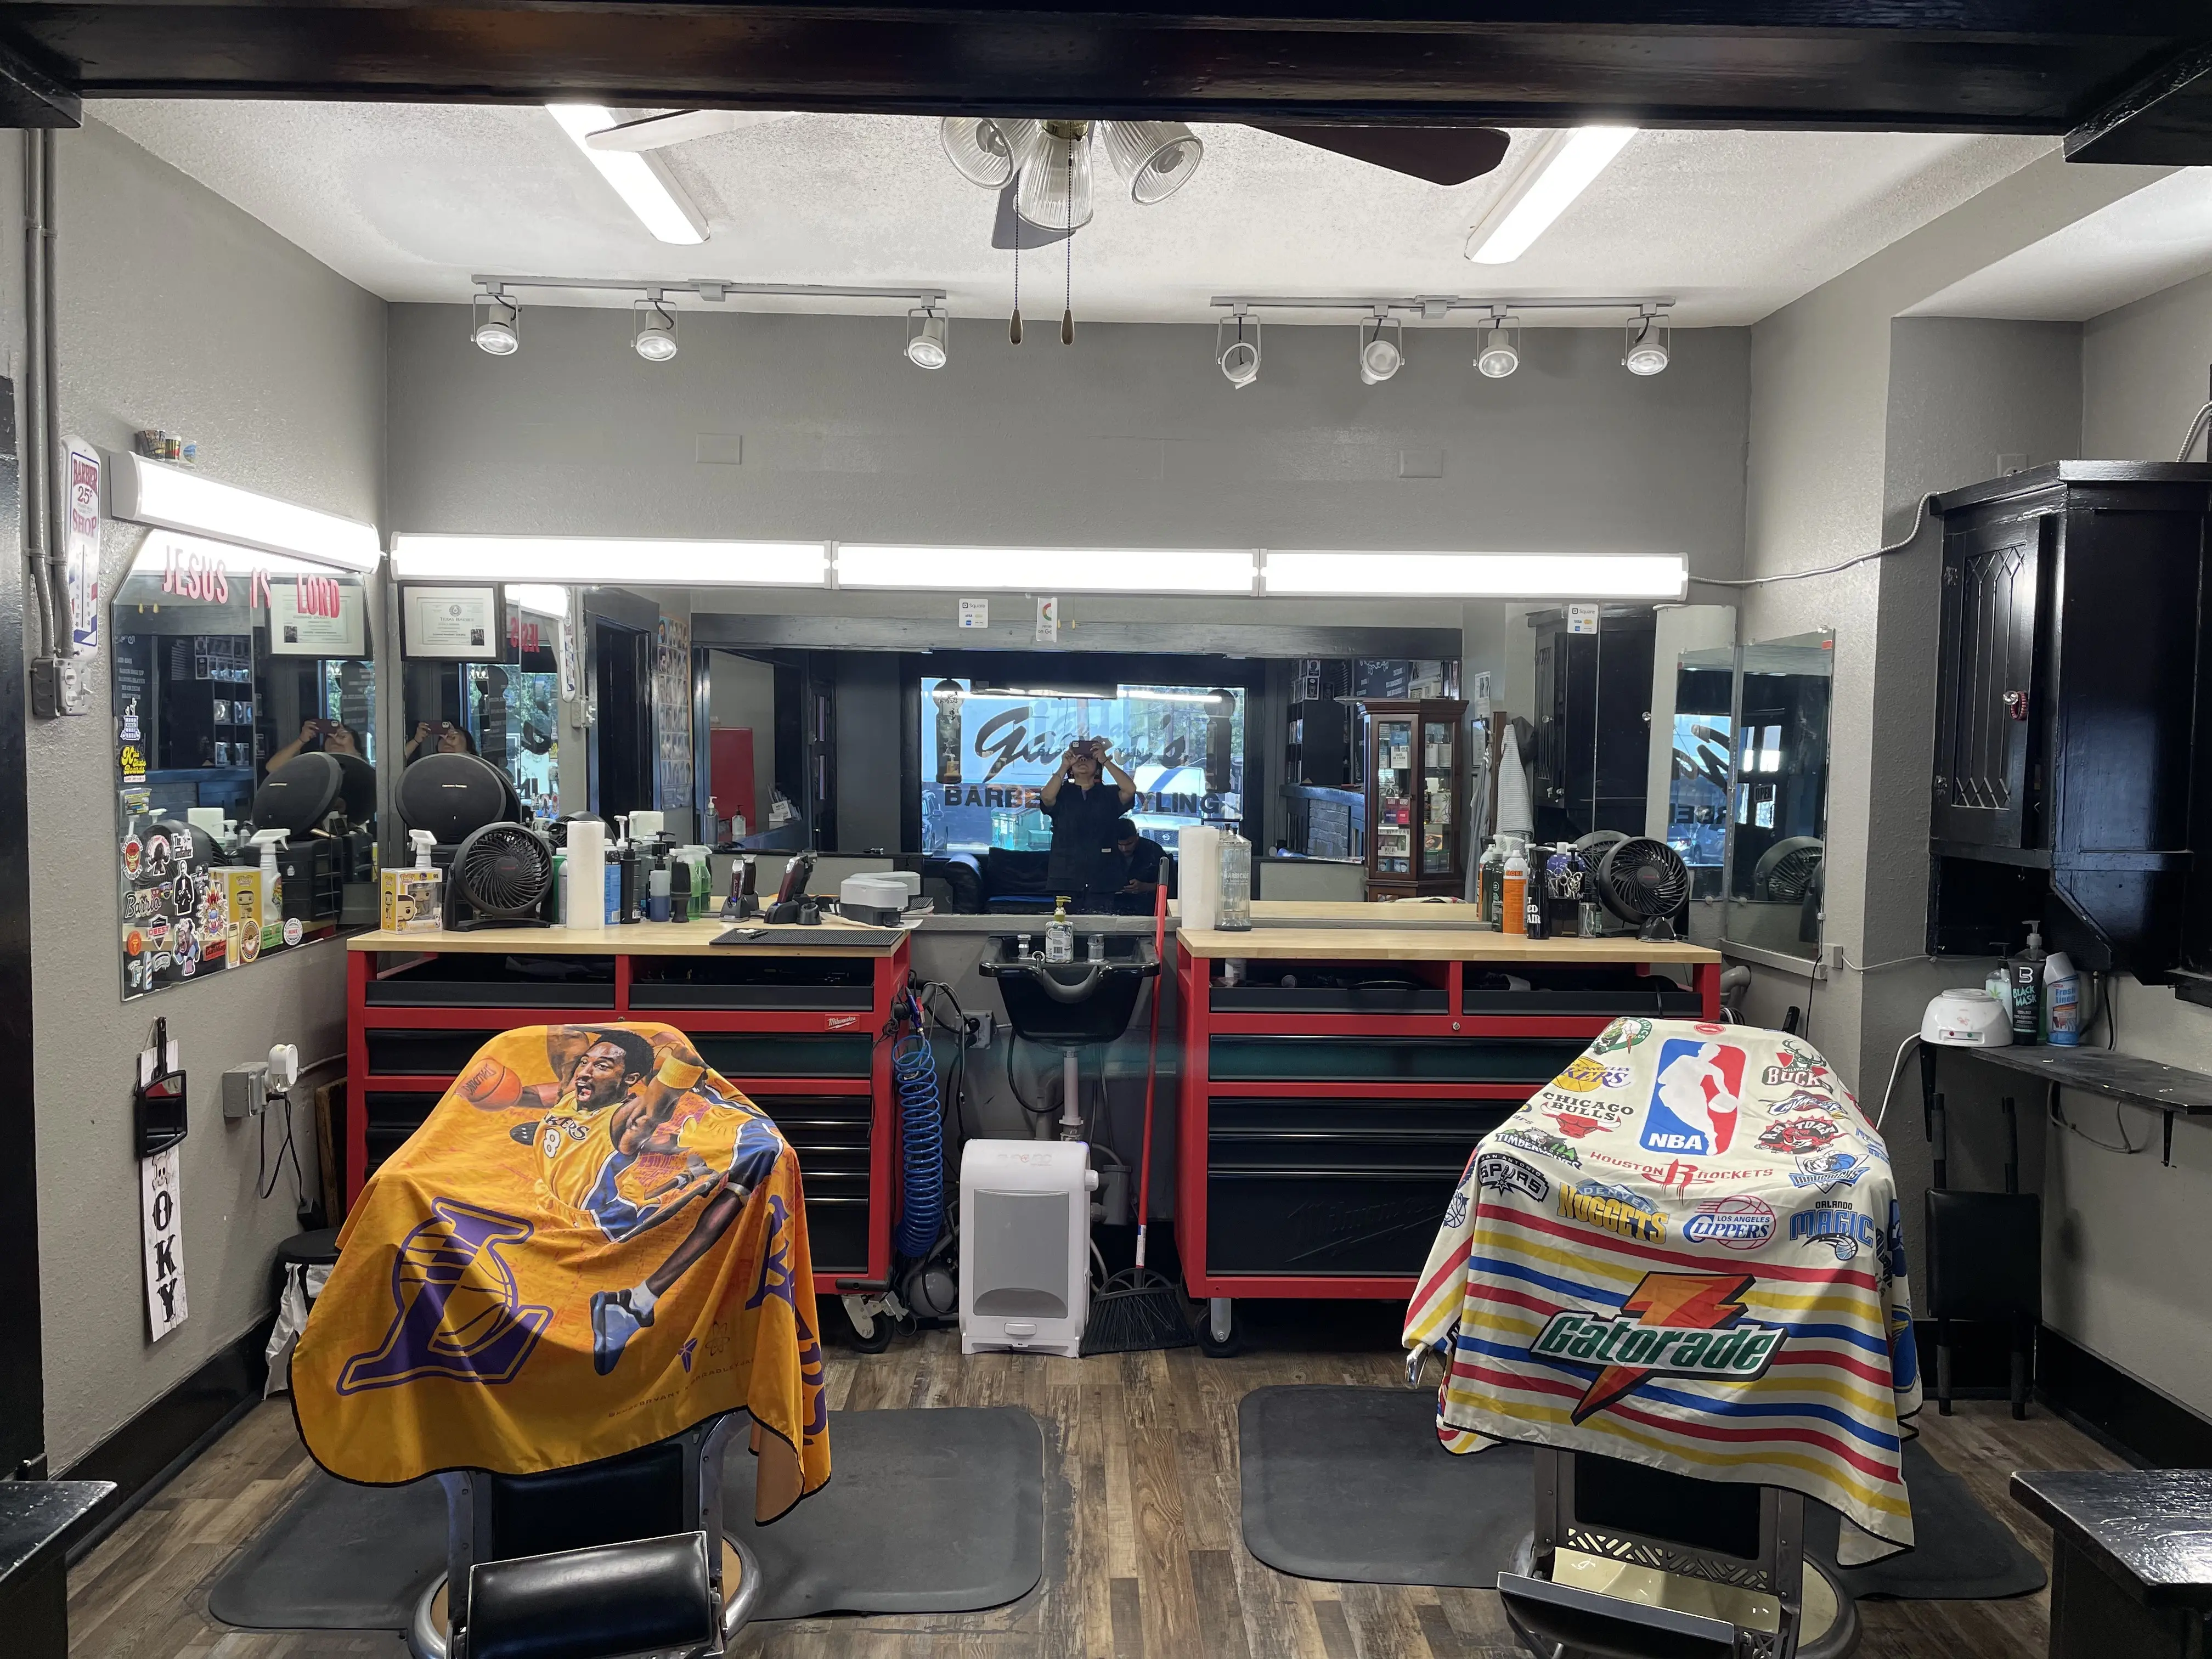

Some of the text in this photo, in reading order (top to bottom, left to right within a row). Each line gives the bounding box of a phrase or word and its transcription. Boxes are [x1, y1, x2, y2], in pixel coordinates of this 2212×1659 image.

[72, 458, 99, 495] BARBER
[72, 507, 97, 537] SHOP
[162, 545, 228, 604] JESUS
[250, 567, 272, 608] IS
[297, 573, 340, 618] LORD
[945, 785, 1220, 814] BARBE YLING
[125, 891, 162, 918] Barrio
[2012, 985, 2035, 998] BLACK
[2016, 994, 2037, 1007] MASK
[1637, 1018, 1649, 1039] CELTICS
[1561, 1066, 1631, 1088] KERS
[1542, 1092, 1634, 1115] CHICAGO
[1550, 1102, 1616, 1121] BULLS
[543, 1128, 561, 1159] 8
[1648, 1133, 1702, 1150] NBA
[1480, 1163, 1542, 1194] SPURS
[1502, 1156, 1541, 1177] ANTONIO
[1590, 1152, 1664, 1176] HOUSTON
[1697, 1169, 1774, 1180] ROCKETS
[1557, 1182, 1671, 1244] NUGGETS
[1583, 1187, 1653, 1214] DENVER
[1815, 1200, 1853, 1210] ORLANDO
[1683, 1214, 1770, 1243] CLIPPERS
[1790, 1209, 1875, 1249] MAGIC
[1538, 1316, 1777, 1370] Gatorade
